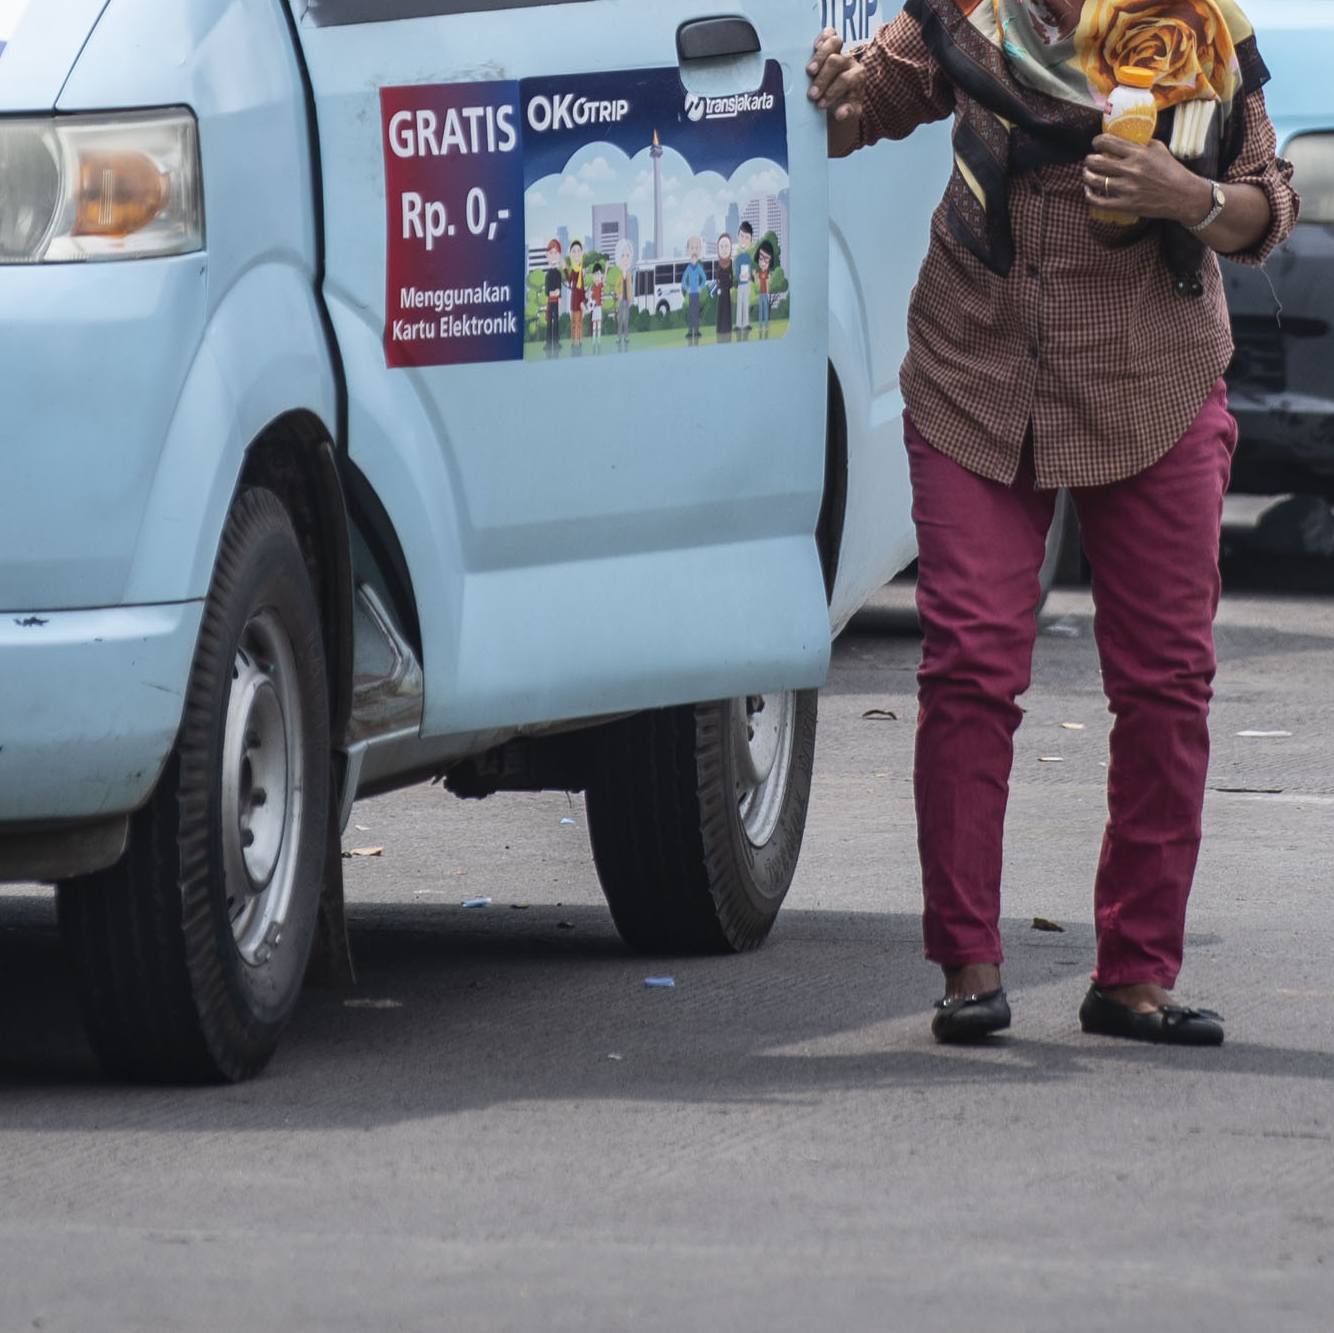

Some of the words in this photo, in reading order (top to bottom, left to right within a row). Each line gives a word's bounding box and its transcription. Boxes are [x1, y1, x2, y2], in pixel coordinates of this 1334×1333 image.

[705, 92, 774, 119] transjakarta
[388, 103, 517, 158] GRATIS
[401, 191, 456, 251] Rp.
[466, 186, 510, 241] 0,-
[400, 283, 510, 314] Menggunakan
[392, 319, 435, 342] Kartu
[439, 314, 516, 338] Elektronik
